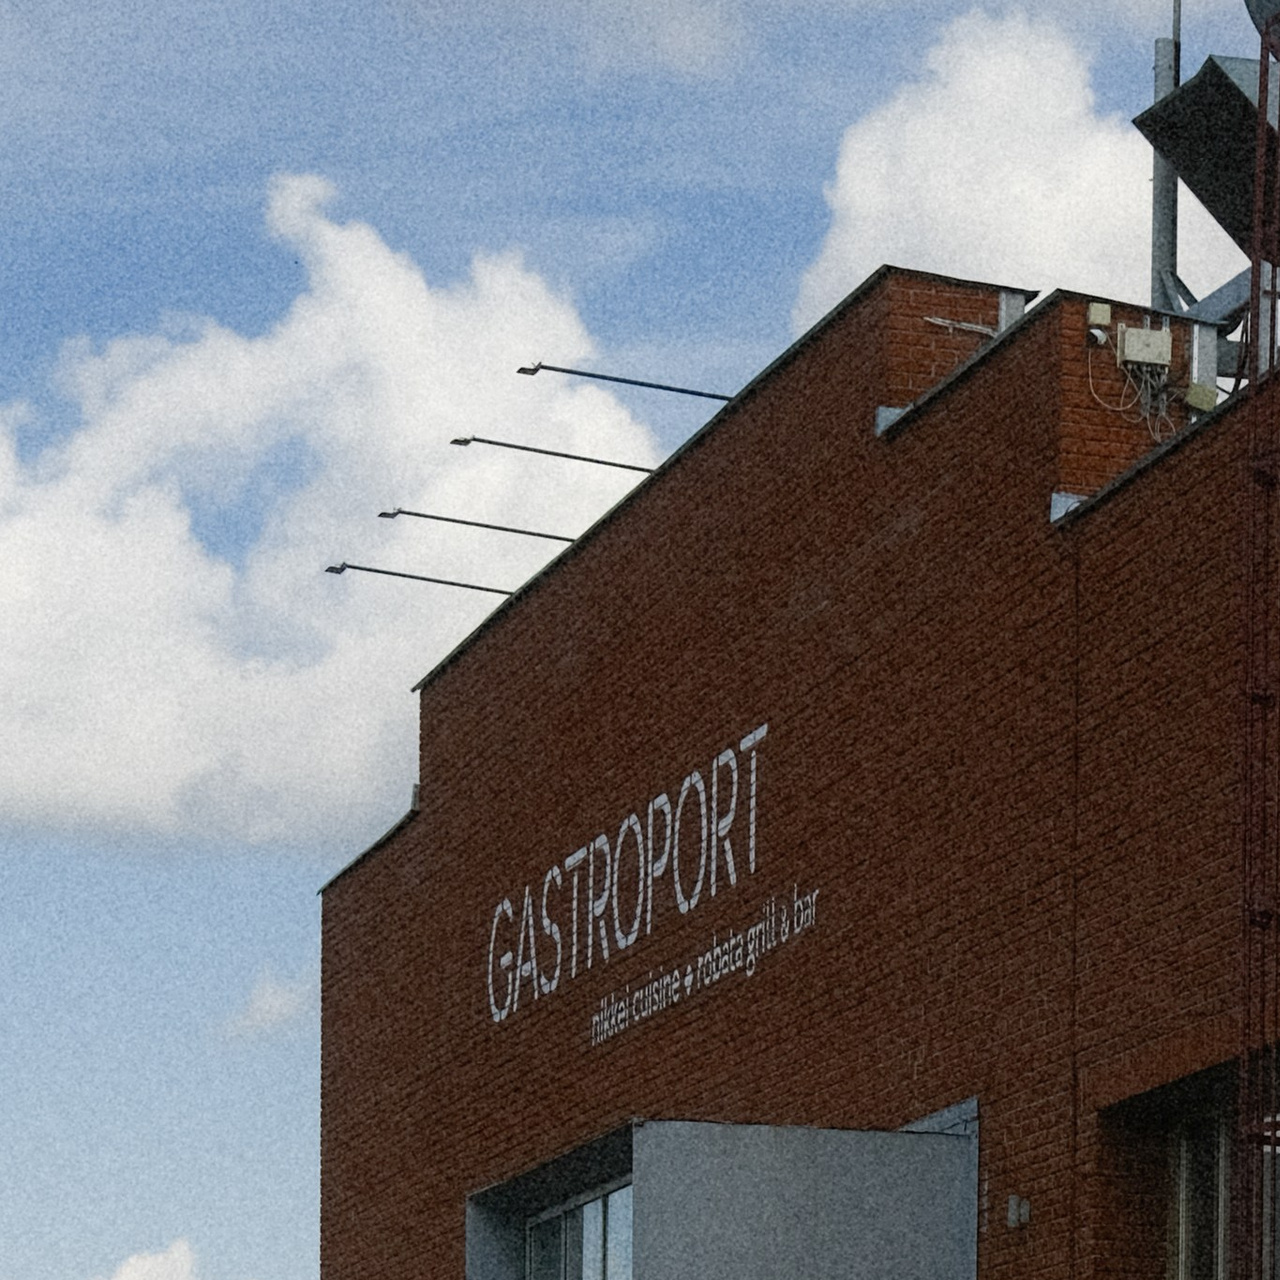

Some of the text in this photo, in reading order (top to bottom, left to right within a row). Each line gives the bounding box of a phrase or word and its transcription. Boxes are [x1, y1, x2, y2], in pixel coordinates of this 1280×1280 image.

[488, 723, 768, 1022] GASTROPORT
[591, 882, 820, 1046] nikkei cuisine robata grill & bar
